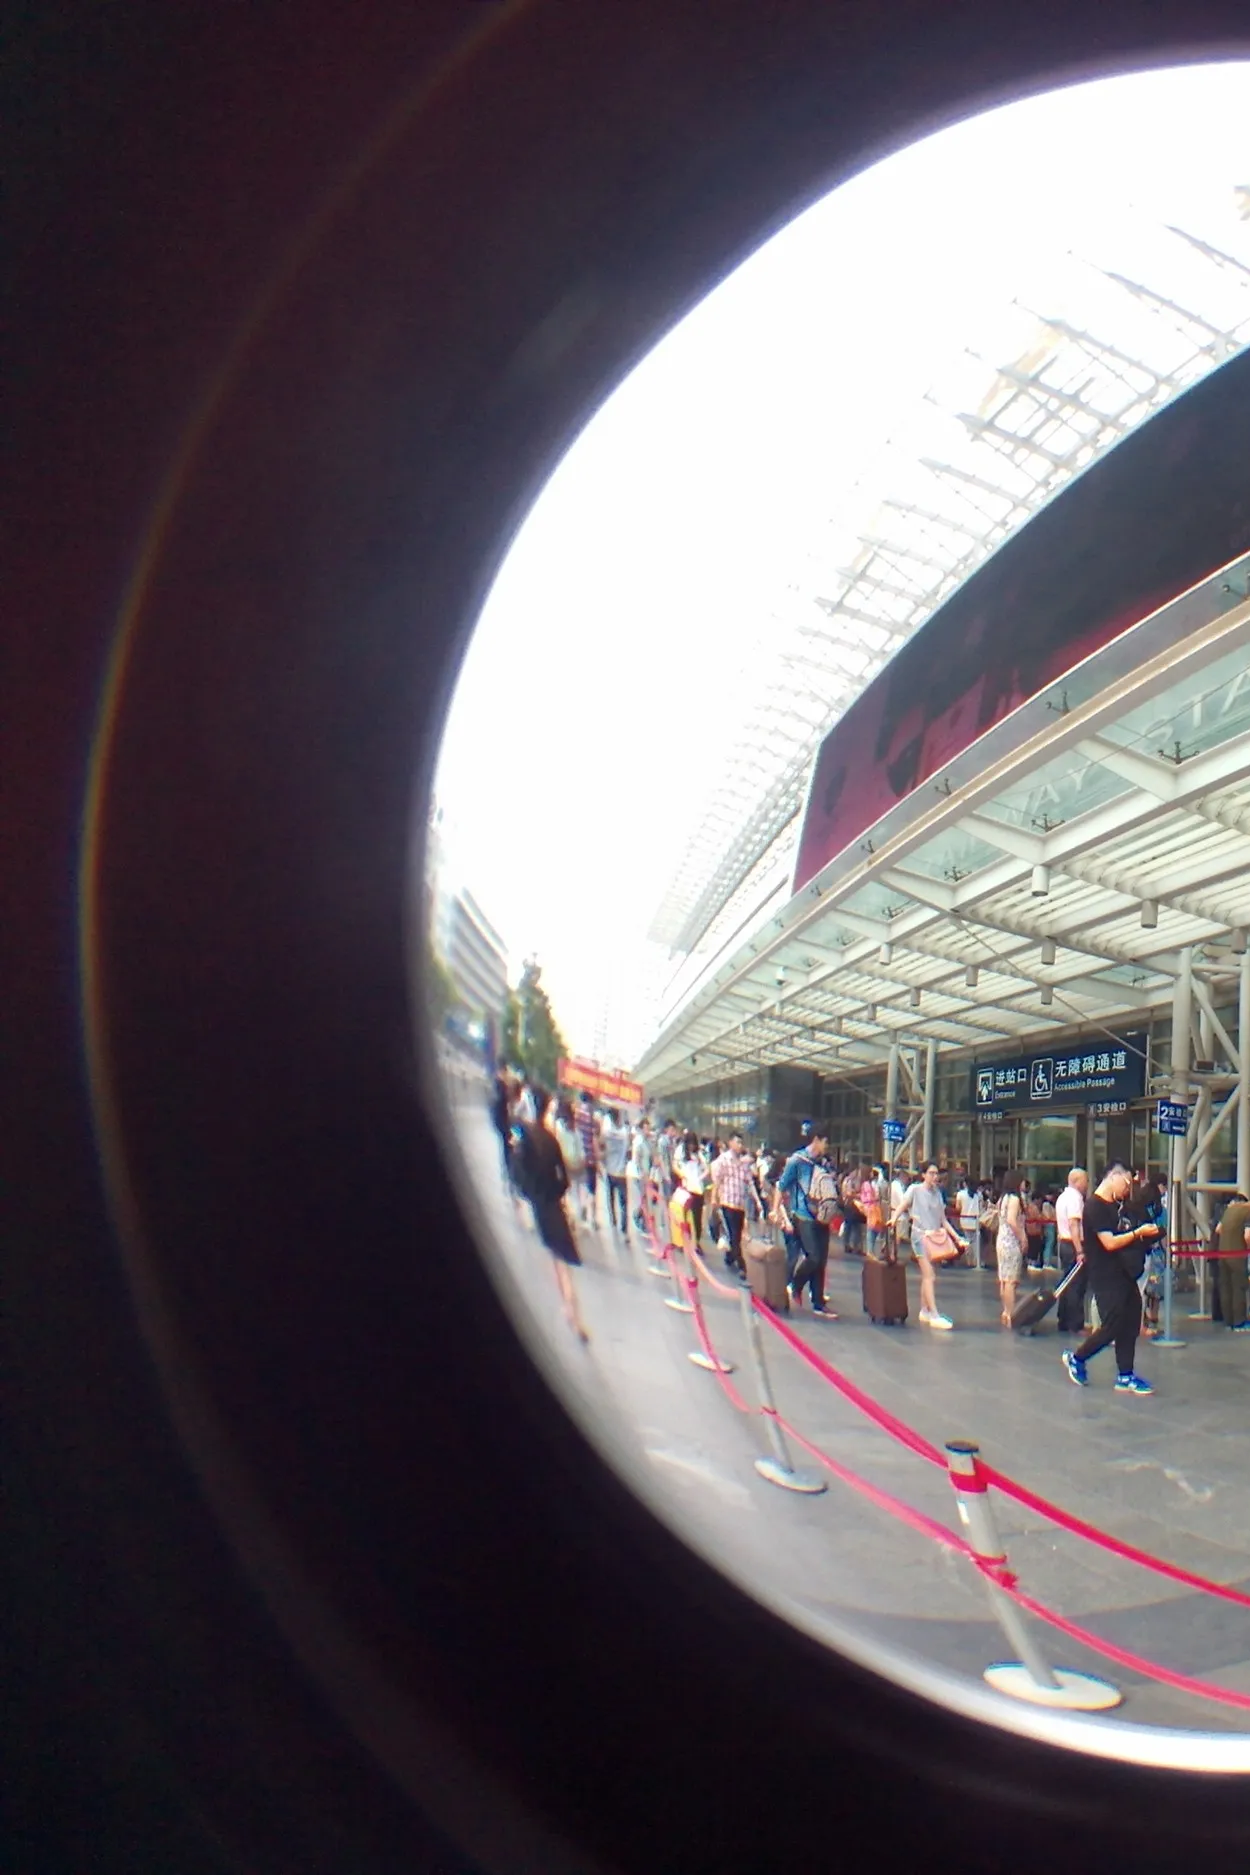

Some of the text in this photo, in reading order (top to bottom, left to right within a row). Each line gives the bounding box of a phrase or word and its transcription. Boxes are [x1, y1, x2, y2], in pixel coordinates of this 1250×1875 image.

[1055, 1051, 1127, 1077] 无障碍通道
[995, 1068, 1027, 1086] 进站口
[1054, 1075, 1115, 1092] Accessible Passage
[1097, 1102, 1127, 1113] 3安检口
